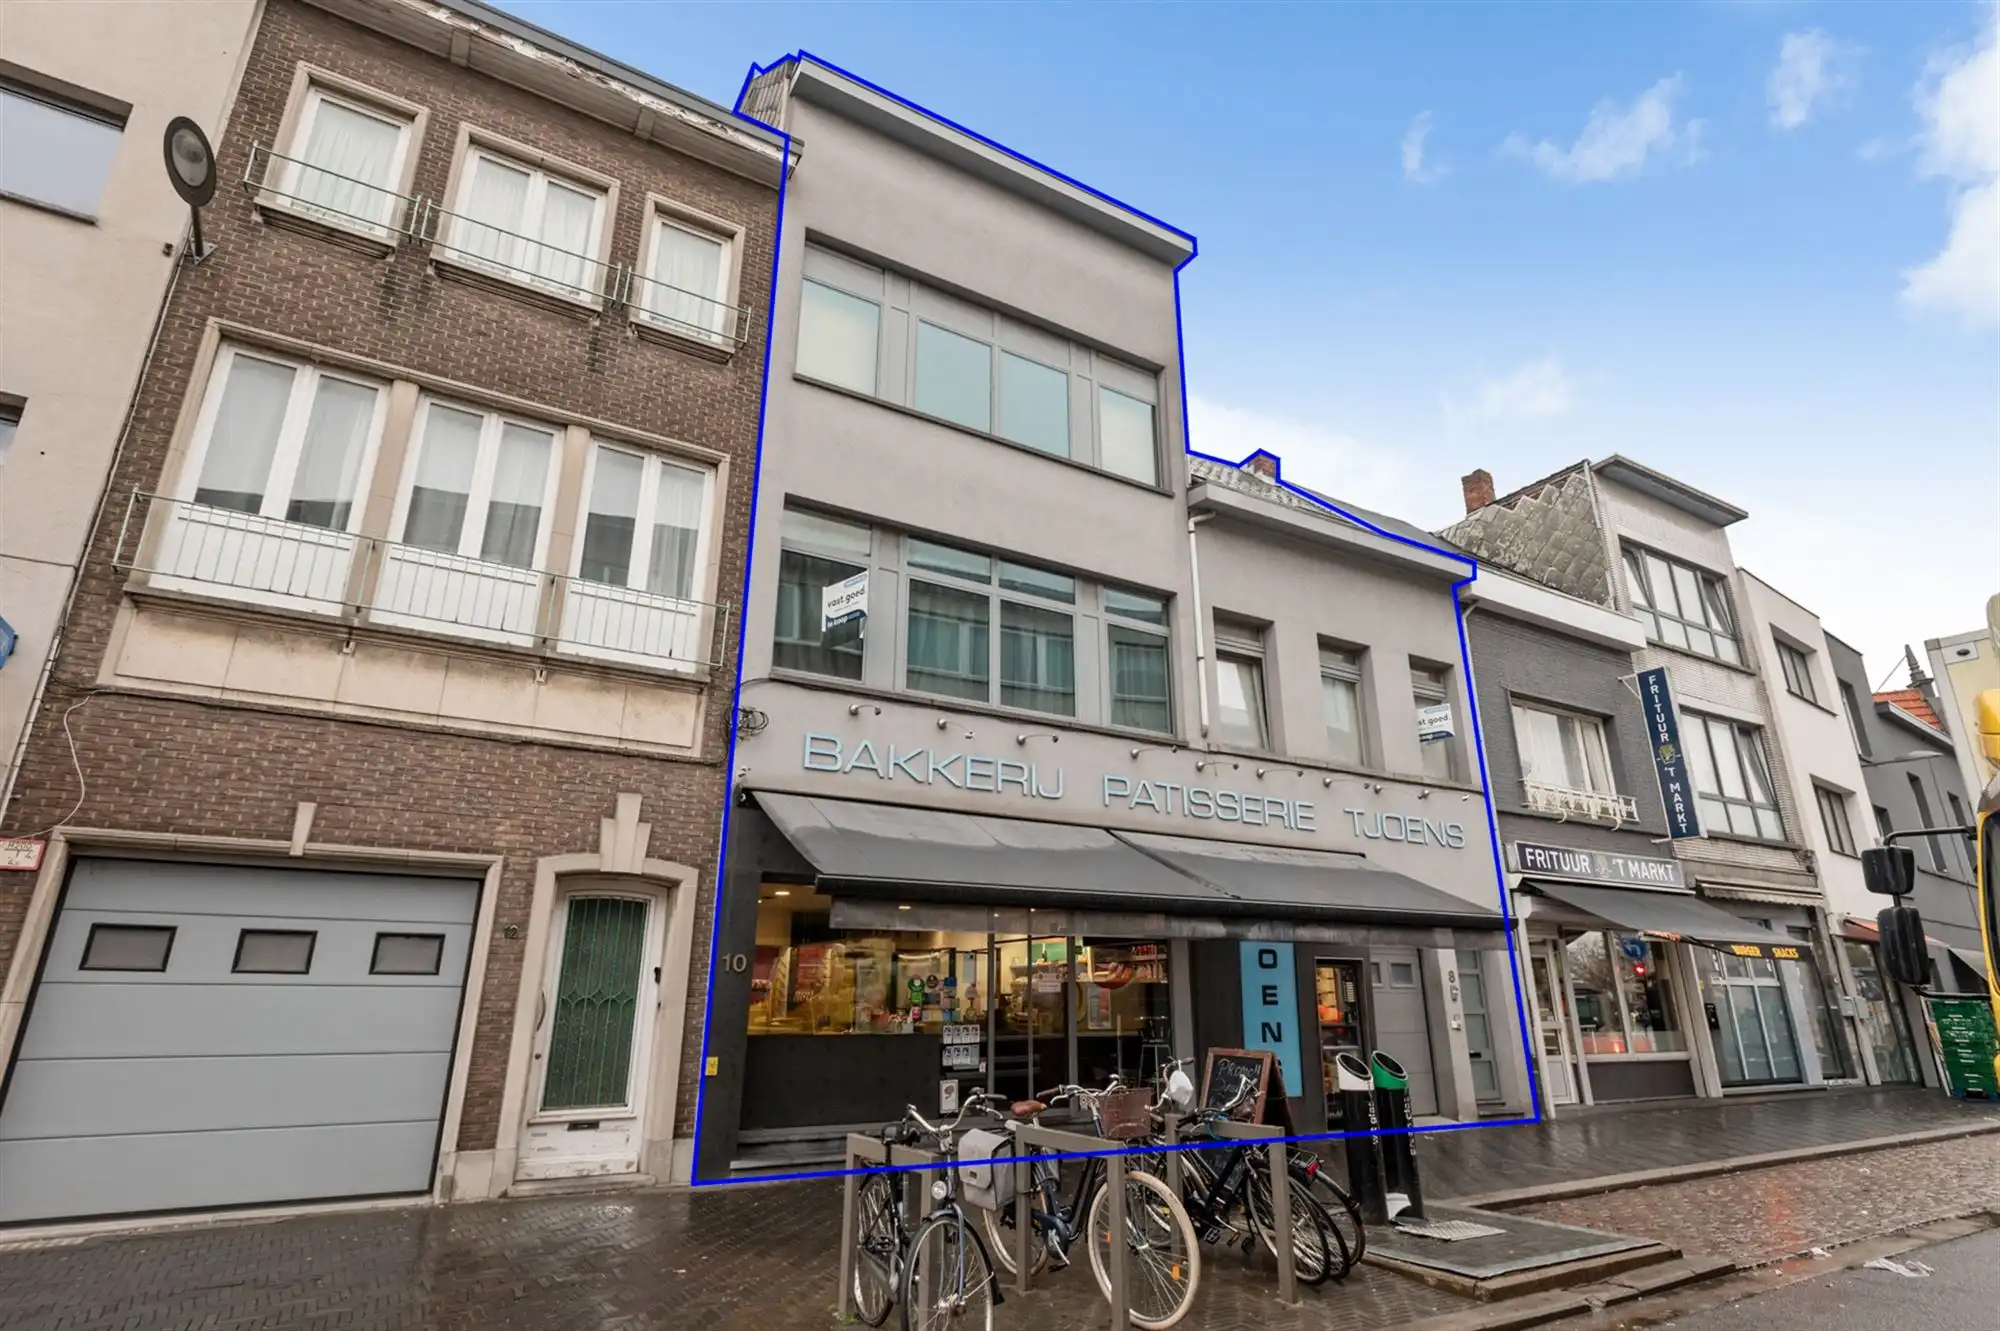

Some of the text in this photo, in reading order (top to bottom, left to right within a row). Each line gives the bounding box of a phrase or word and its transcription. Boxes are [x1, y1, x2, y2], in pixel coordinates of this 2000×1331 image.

[1648, 675, 1669, 743] FRITUUR
[1669, 783, 1688, 833] MARKT
[803, 731, 1466, 849] BAKKERIJ PATISSERIE TJOENS
[1525, 847, 1592, 875] FRITUUR
[1628, 860, 1674, 882] MARKT
[721, 952, 748, 973] 10
[1772, 946, 1800, 960] SNACKS
[1448, 970, 1456, 984] 8
[1257, 947, 1284, 1078] OEN
